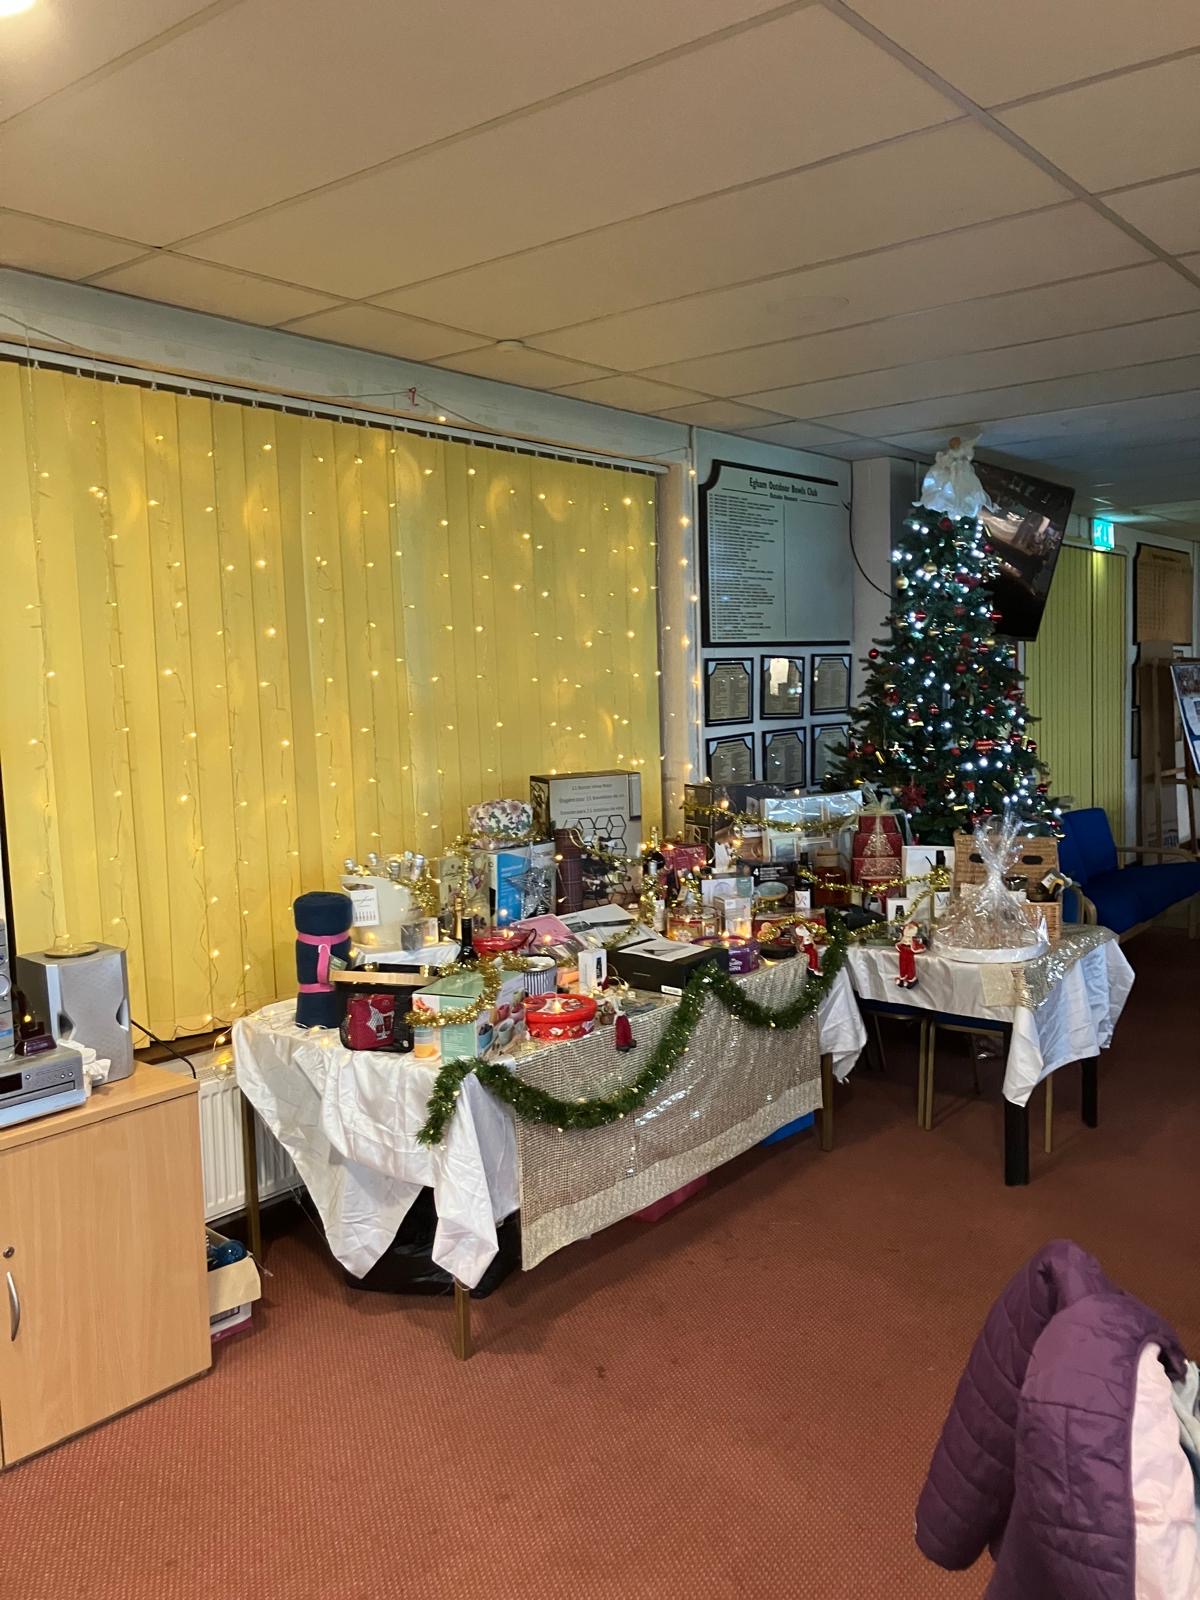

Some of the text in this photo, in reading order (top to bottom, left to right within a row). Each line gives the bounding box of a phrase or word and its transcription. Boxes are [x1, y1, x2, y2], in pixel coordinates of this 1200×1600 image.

[749, 477, 818, 497] Egham Outdoor Bowls Club
[753, 867, 759, 876] 4
